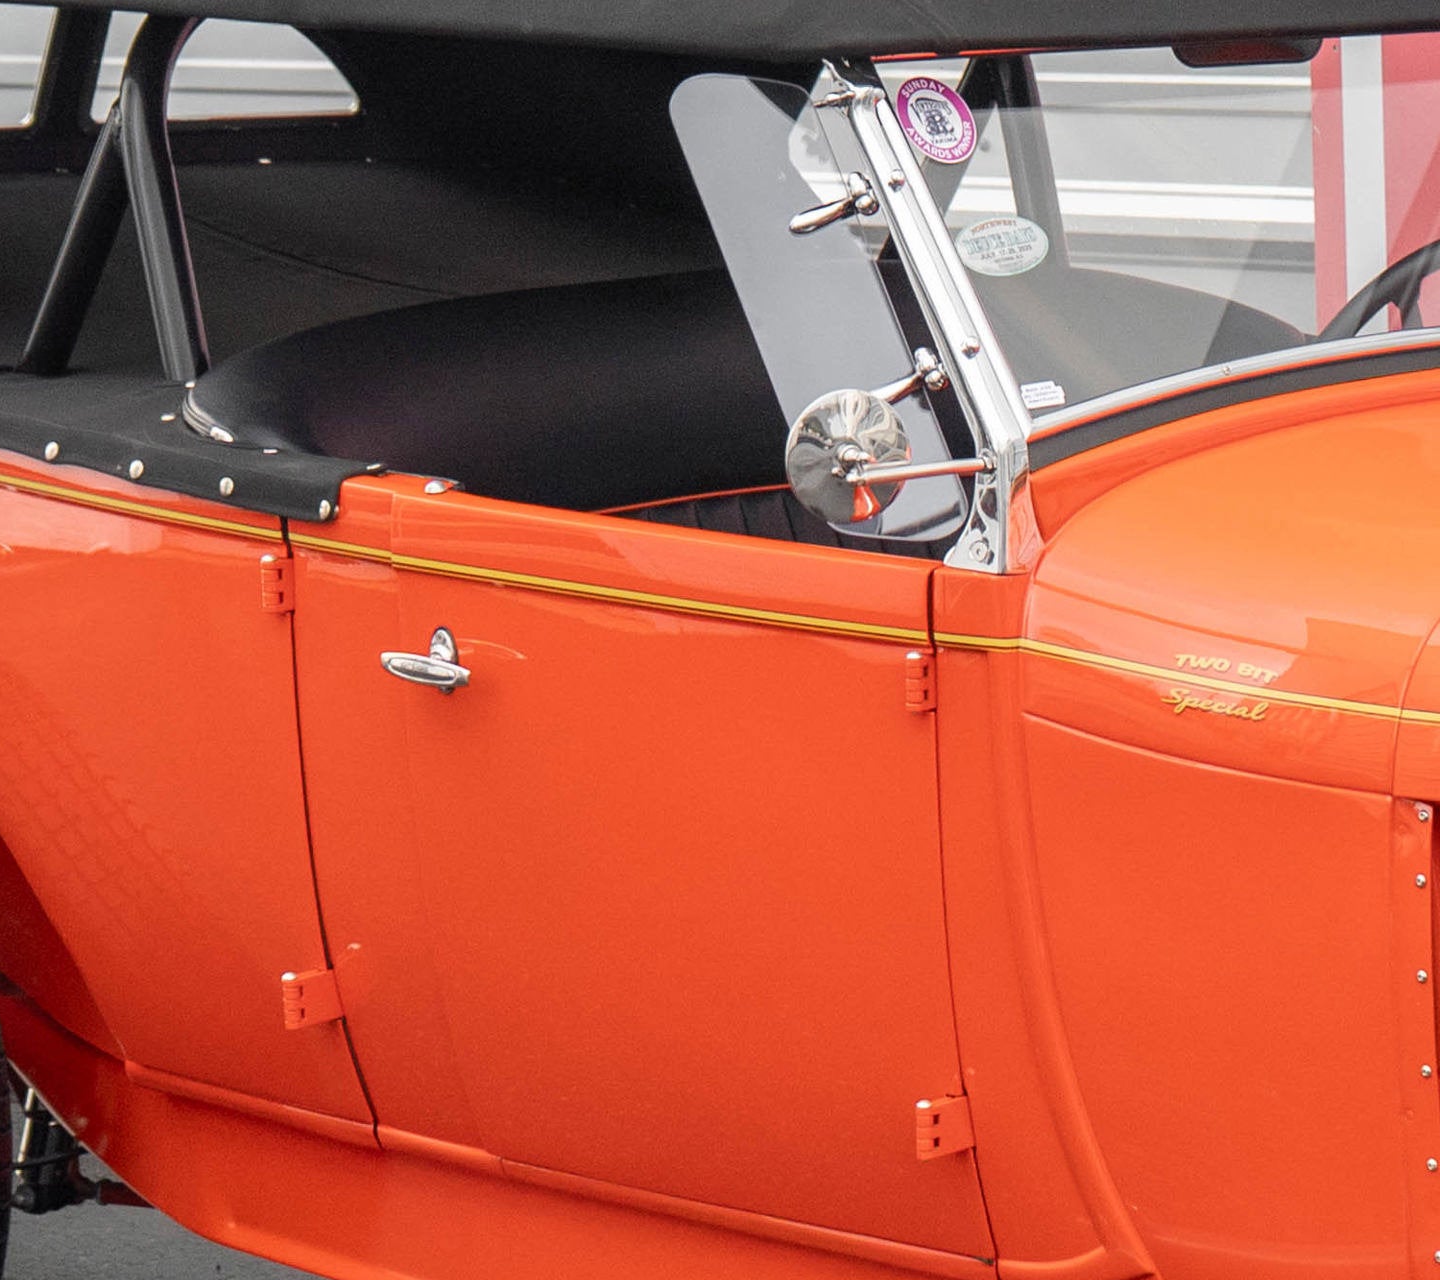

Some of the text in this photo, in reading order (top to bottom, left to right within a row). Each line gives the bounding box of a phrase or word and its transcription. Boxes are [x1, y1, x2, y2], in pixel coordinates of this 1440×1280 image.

[901, 79, 945, 98] SUNDAY
[906, 121, 972, 159] AWARDS WINNER
[1175, 653, 1279, 683] TWO BIT
[1161, 688, 1270, 721] Special
